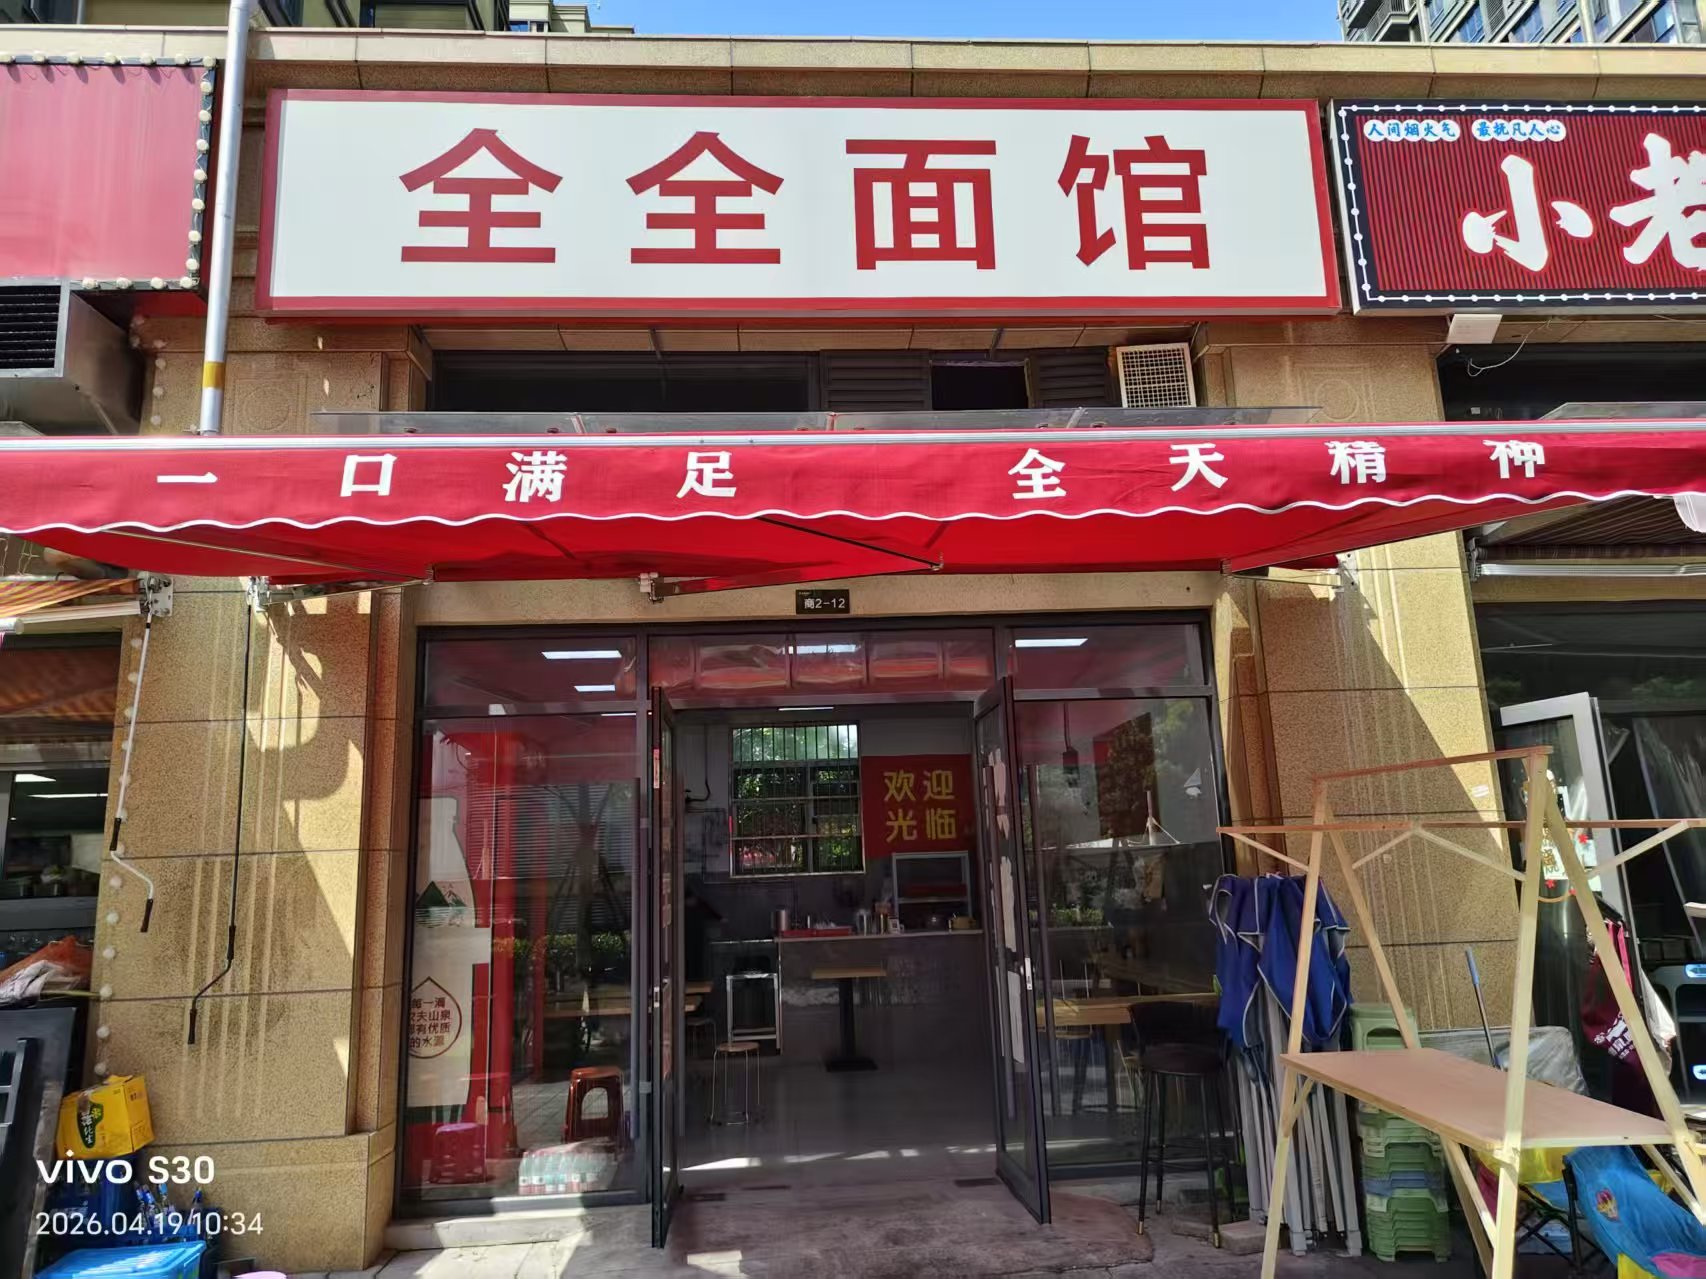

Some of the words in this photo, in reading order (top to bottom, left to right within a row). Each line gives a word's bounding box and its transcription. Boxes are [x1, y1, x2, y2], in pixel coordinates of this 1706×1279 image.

[1368, 122, 1456, 138] 人间烟火气
[1476, 121, 1561, 138] 最抚凡人心
[402, 128, 1211, 271] 全全面馆
[156, 451, 738, 503] 一口满足
[804, 598, 846, 609] 商2-12
[883, 769, 956, 802] 欢迎
[885, 808, 956, 842] 光临
